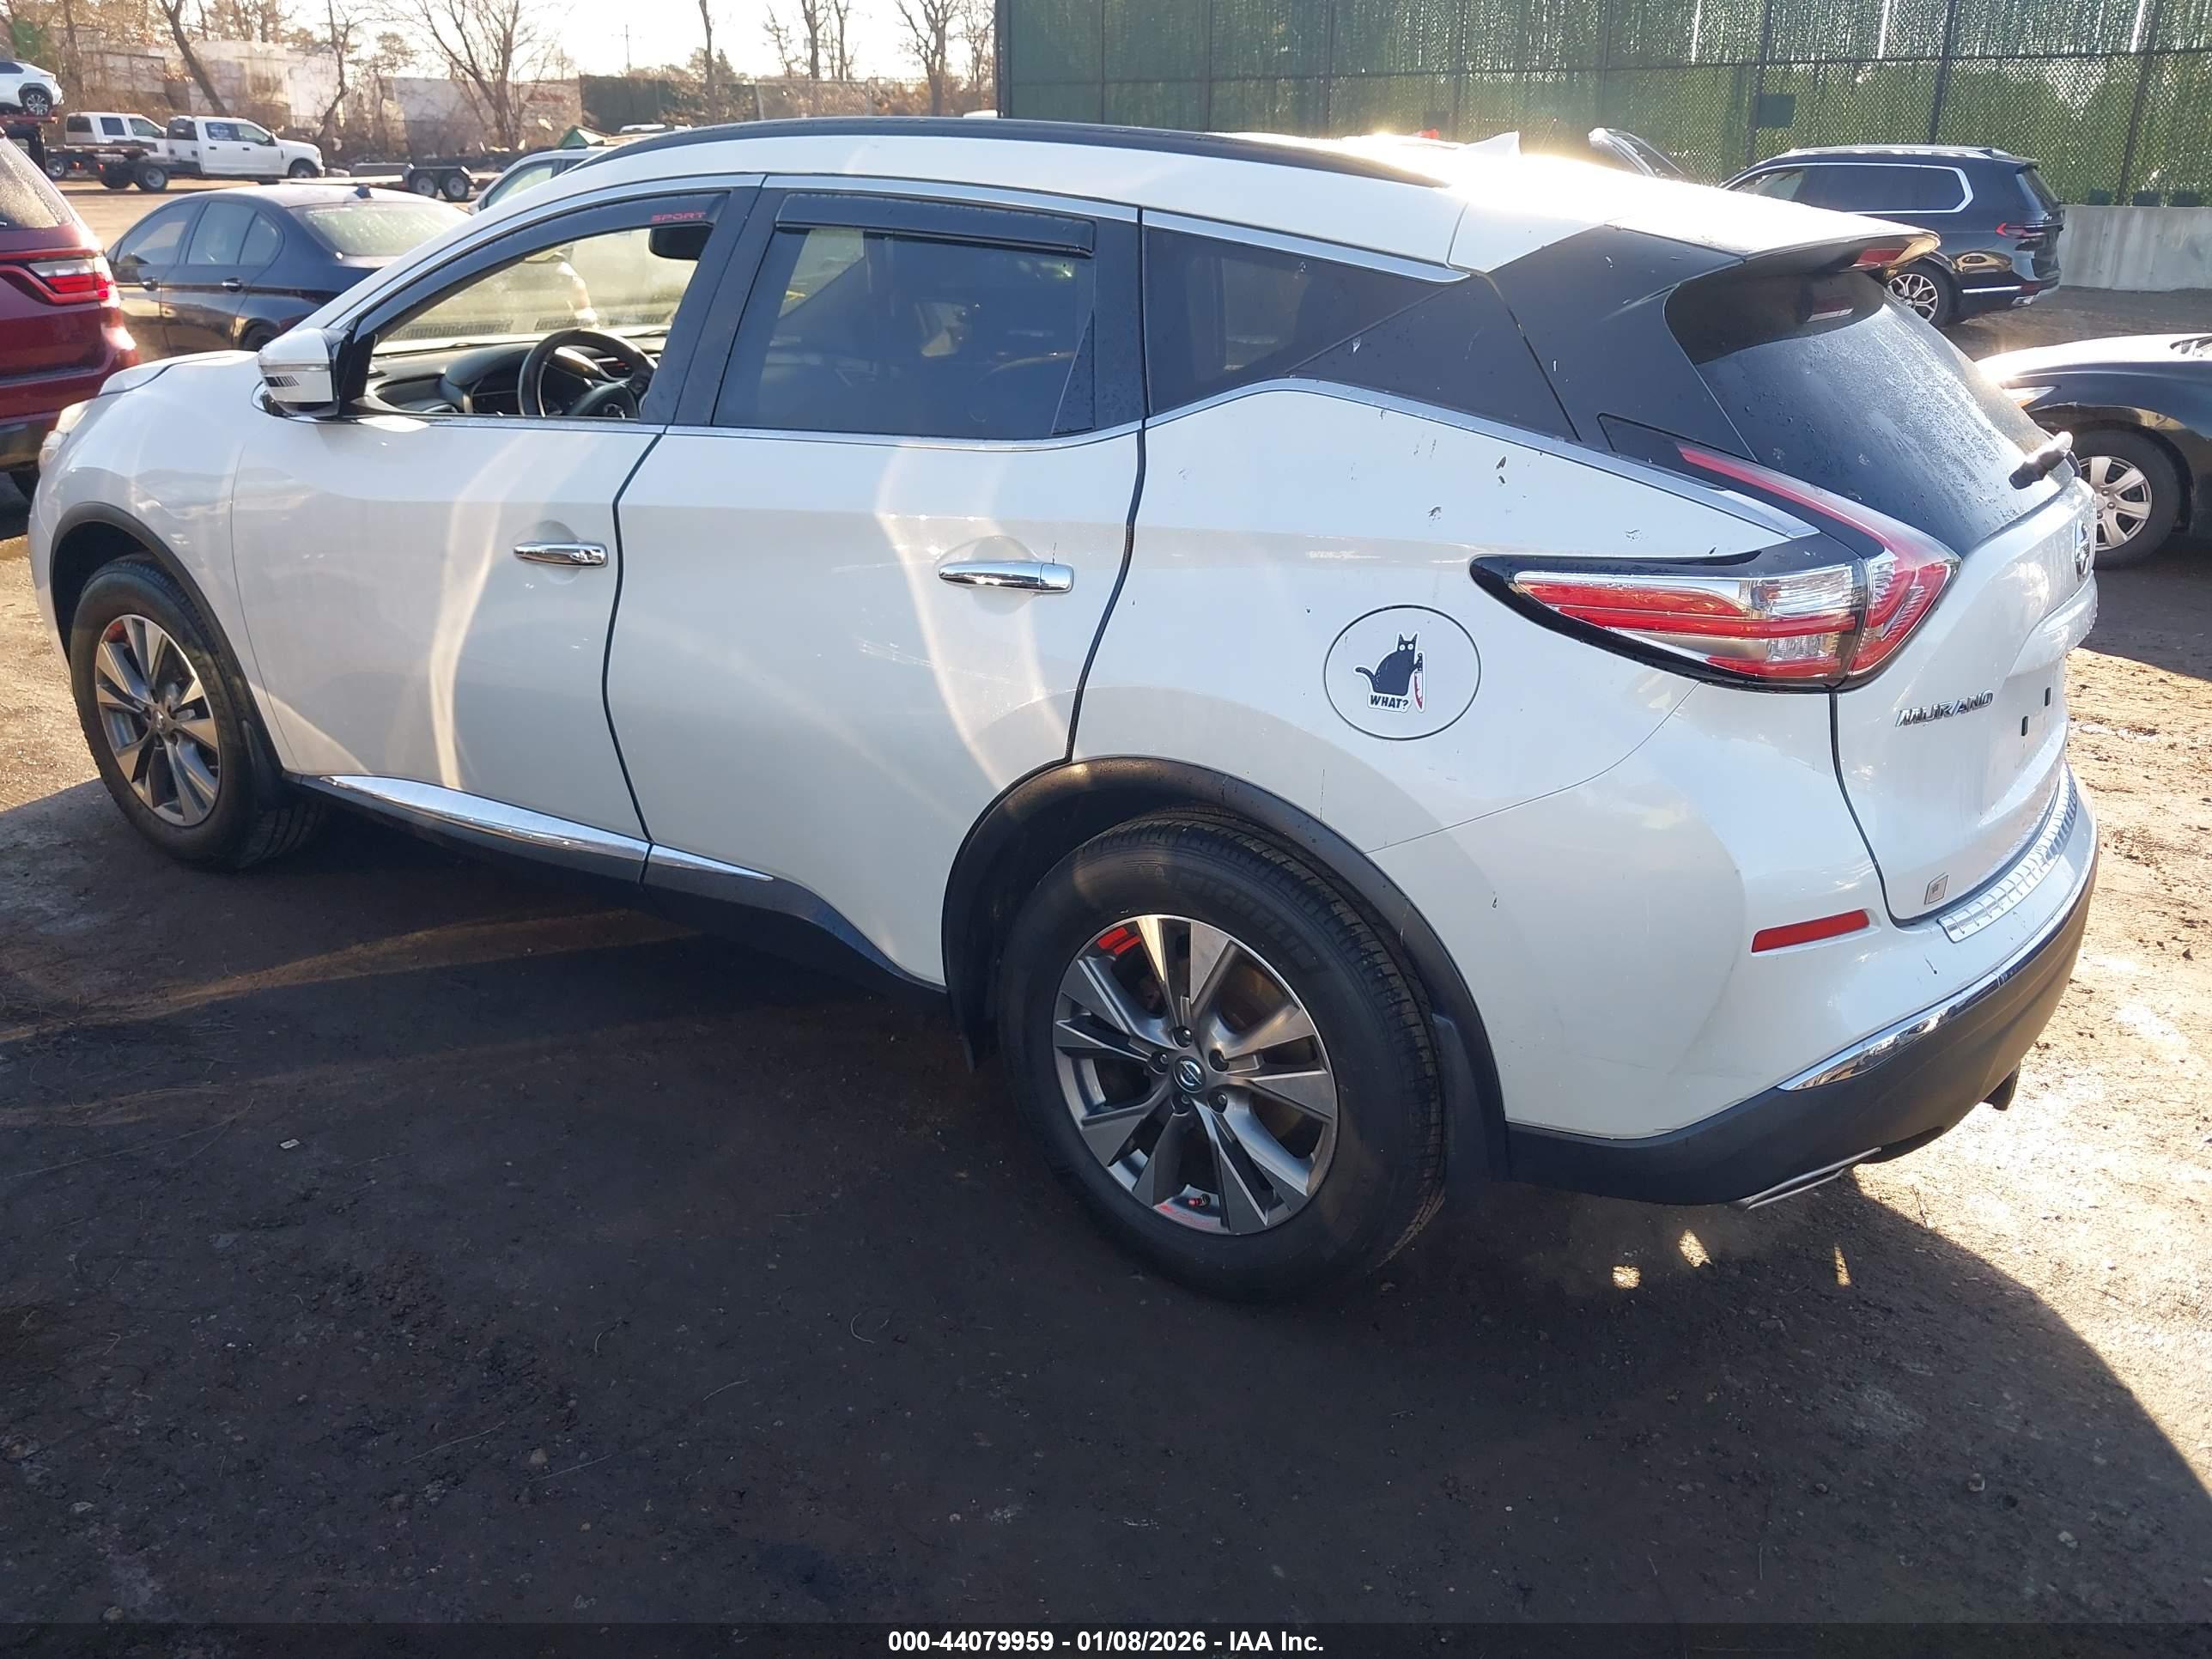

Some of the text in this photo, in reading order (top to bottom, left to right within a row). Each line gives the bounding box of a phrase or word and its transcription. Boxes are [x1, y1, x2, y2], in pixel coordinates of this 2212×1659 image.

[651, 212, 706, 222] SPORT
[1370, 695, 1409, 709] WHAT?
[1895, 690, 1993, 726] MURANO
